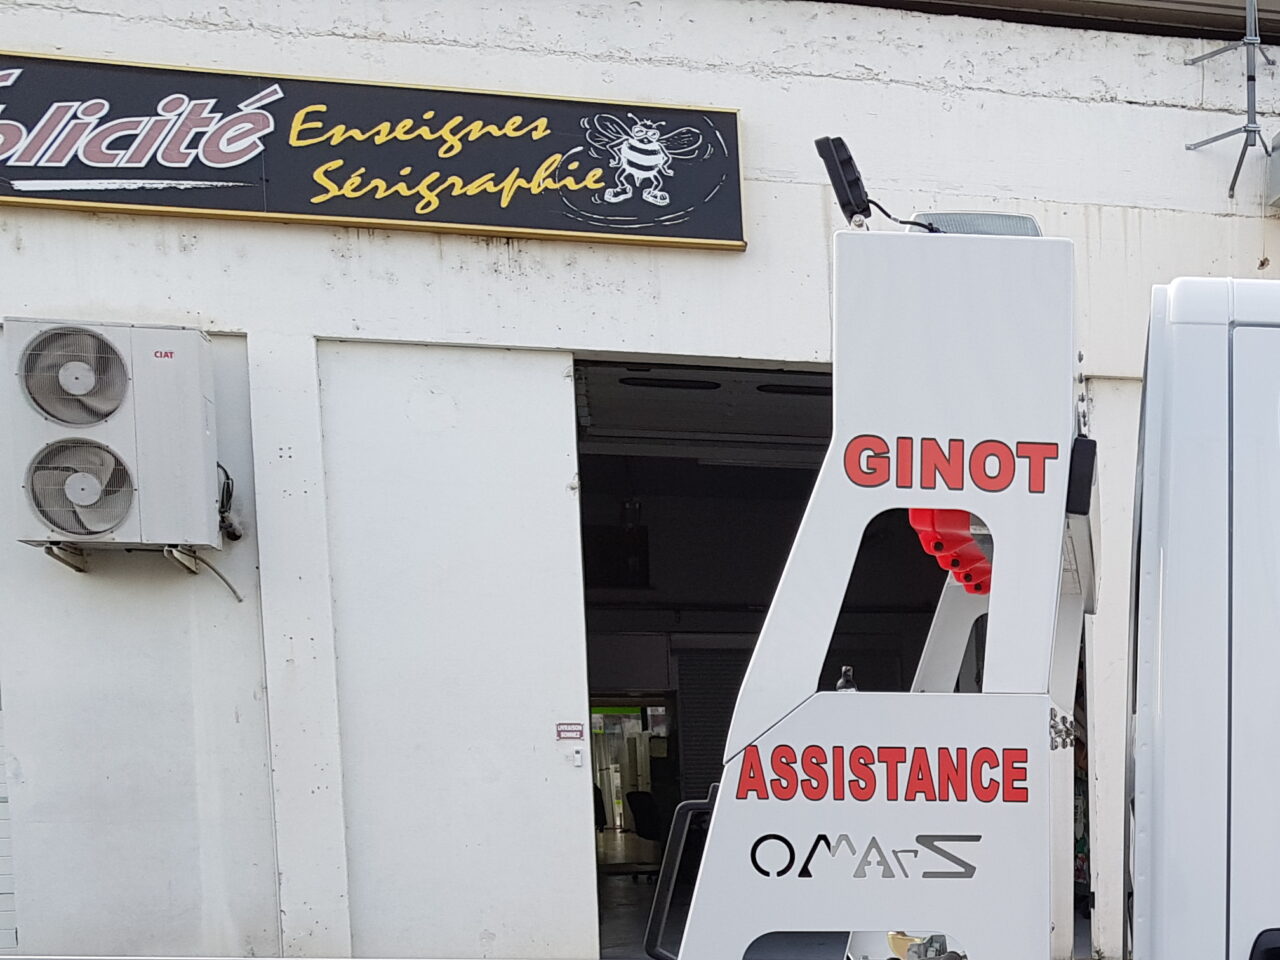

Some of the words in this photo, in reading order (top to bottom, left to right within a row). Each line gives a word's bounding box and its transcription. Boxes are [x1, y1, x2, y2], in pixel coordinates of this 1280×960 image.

[289, 104, 551, 158] Enseignes
[310, 154, 605, 215] Sérigraphie
[154, 350, 175, 359] CIAT
[844, 434, 1060, 493] GINOT
[735, 744, 1029, 803] ASSISTANCE
